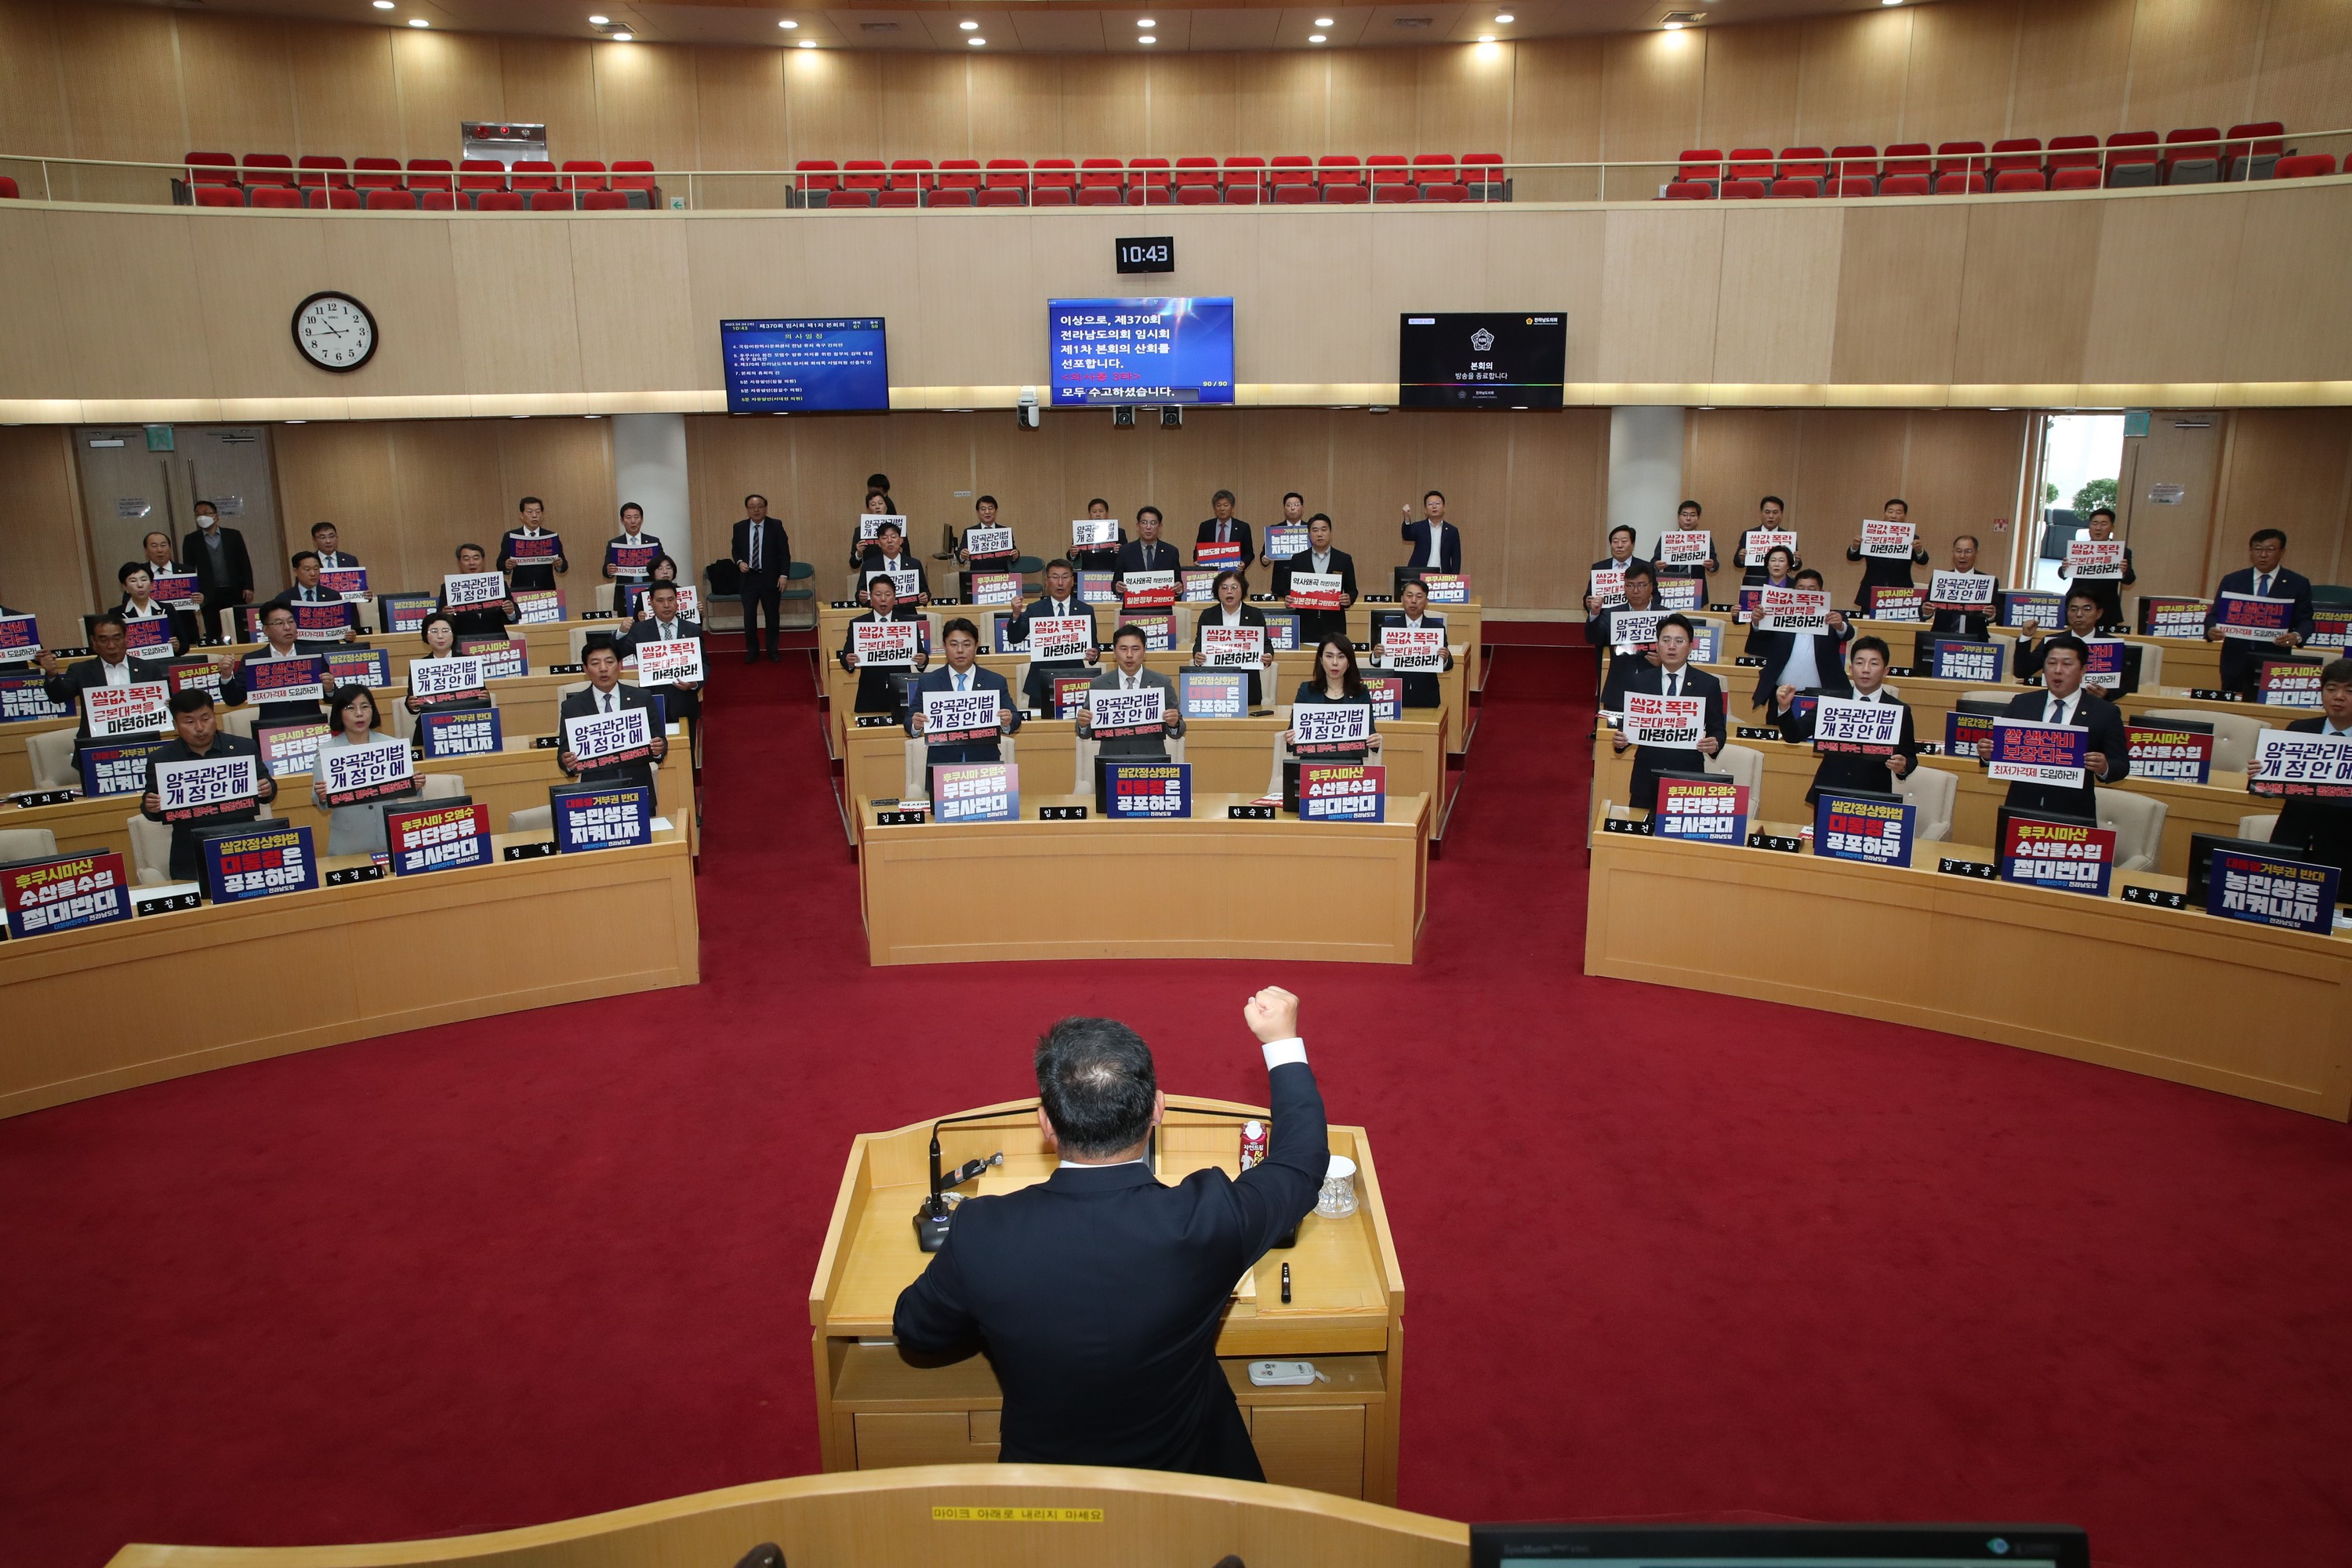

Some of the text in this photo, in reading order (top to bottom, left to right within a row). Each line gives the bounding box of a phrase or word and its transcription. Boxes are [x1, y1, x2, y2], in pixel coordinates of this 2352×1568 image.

[1123, 245, 1167, 263] 10:43
[1061, 314, 1160, 325] 이상으로, 제370회
[1061, 329, 1170, 340] 전라남도의회 임시회
[1061, 344, 1170, 354] 제1차 본회의 산회를
[1062, 359, 1123, 368] 선포합니다.
[1062, 372, 1140, 382] <의사봉 3타>
[1062, 387, 1174, 397] 모두 수고하셨습니다.
[1867, 524, 1911, 536] 쌀값 폭락
[1665, 534, 1706, 543] 쌀값 폭락
[1664, 544, 1700, 554] 근본대책을
[1671, 551, 1706, 562] 마련하라!
[1871, 544, 1908, 554] 마련하라!
[451, 575, 499, 590] 양곡관리법
[1937, 579, 1990, 590] 양곡관리법
[1766, 590, 1824, 606] 쌀값 폭락
[1764, 604, 1816, 615] 근본대책을
[1773, 615, 1824, 628] 마련하라!
[858, 626, 911, 639] 쌀값 폭락
[1386, 632, 1439, 644] 쌀값 폭락
[642, 642, 695, 659] 쌀값 폭락
[858, 639, 904, 652] 근본대책을
[1385, 646, 1431, 656] 근본대책을
[868, 648, 913, 662] 마련하라!
[1394, 655, 1439, 667] 마련하라!
[643, 655, 688, 672] 근본대책을
[652, 663, 698, 680] 마련하라!
[257, 672, 311, 688] 보장되는
[252, 687, 318, 701] 최저가격제 도입하라!
[931, 695, 994, 714] 양곡관리법
[1096, 693, 1160, 712] 양곡관리법
[1630, 697, 1698, 716] 쌀값 폭락
[1299, 710, 1364, 726] 양곡관리법
[1628, 715, 1686, 728] 근본대책을
[1823, 707, 1896, 724] 양곡관리법
[575, 713, 641, 740] 양곡관리법
[1639, 727, 1696, 742] 마련하라!
[2004, 729, 2074, 748] 쌀 생산비
[330, 744, 404, 773] 양곡관리법
[2003, 746, 2073, 765] 보장되는
[166, 761, 249, 788] 양곡관리법
[942, 766, 1006, 782] 후쿠시마 오염수
[1117, 768, 1179, 778] 쌀값정상화법
[1308, 767, 1364, 781] 후쿠시마산
[1994, 765, 2078, 781] 최저가격제 도입하라!
[943, 775, 1007, 799] 무단방류
[1116, 779, 1181, 794] 대통령은
[1308, 779, 1377, 796] 수산물수입
[1668, 786, 1737, 797] 후쿠시마 오염수
[621, 793, 639, 803] 반대
[943, 794, 1007, 818] 결사반대
[1117, 796, 1181, 811] 공포하라
[1308, 794, 1376, 815] 절대반대
[1666, 797, 1735, 815] 무단방류
[568, 804, 638, 826] 농민생존
[1831, 800, 1904, 820] 쌀값정상화법
[401, 807, 474, 831] 후쿠시마 오염수
[1664, 815, 1733, 833] 결사반대
[1828, 815, 1901, 839] 대통령은
[402, 818, 477, 849] 무단방류
[569, 821, 640, 844] 지켜내자
[2018, 826, 2088, 841] 후쿠시마산
[220, 833, 299, 855] 쌀값정상화법
[1826, 832, 1900, 857] 공포하라
[2015, 843, 2102, 859] 수산물수입
[220, 847, 302, 874] 대통령은
[405, 840, 478, 870] 결사반대
[456, 854, 480, 864] 전라남도당
[16, 858, 93, 888] 후쿠시마산
[2013, 859, 2100, 881] 절대반대
[2299, 869, 2325, 882] 반대
[223, 865, 305, 892] 공포하라
[2225, 871, 2320, 902] 농민생존
[20, 869, 114, 907] 수산물수입
[268, 884, 295, 894] 전라남도당
[22, 888, 118, 931] 절대반대
[89, 909, 119, 920] 전라남도당
[2222, 890, 2318, 923] 지켜내자
[934, 1508, 1102, 1520] 마이크 아래로 내리지 마세요
